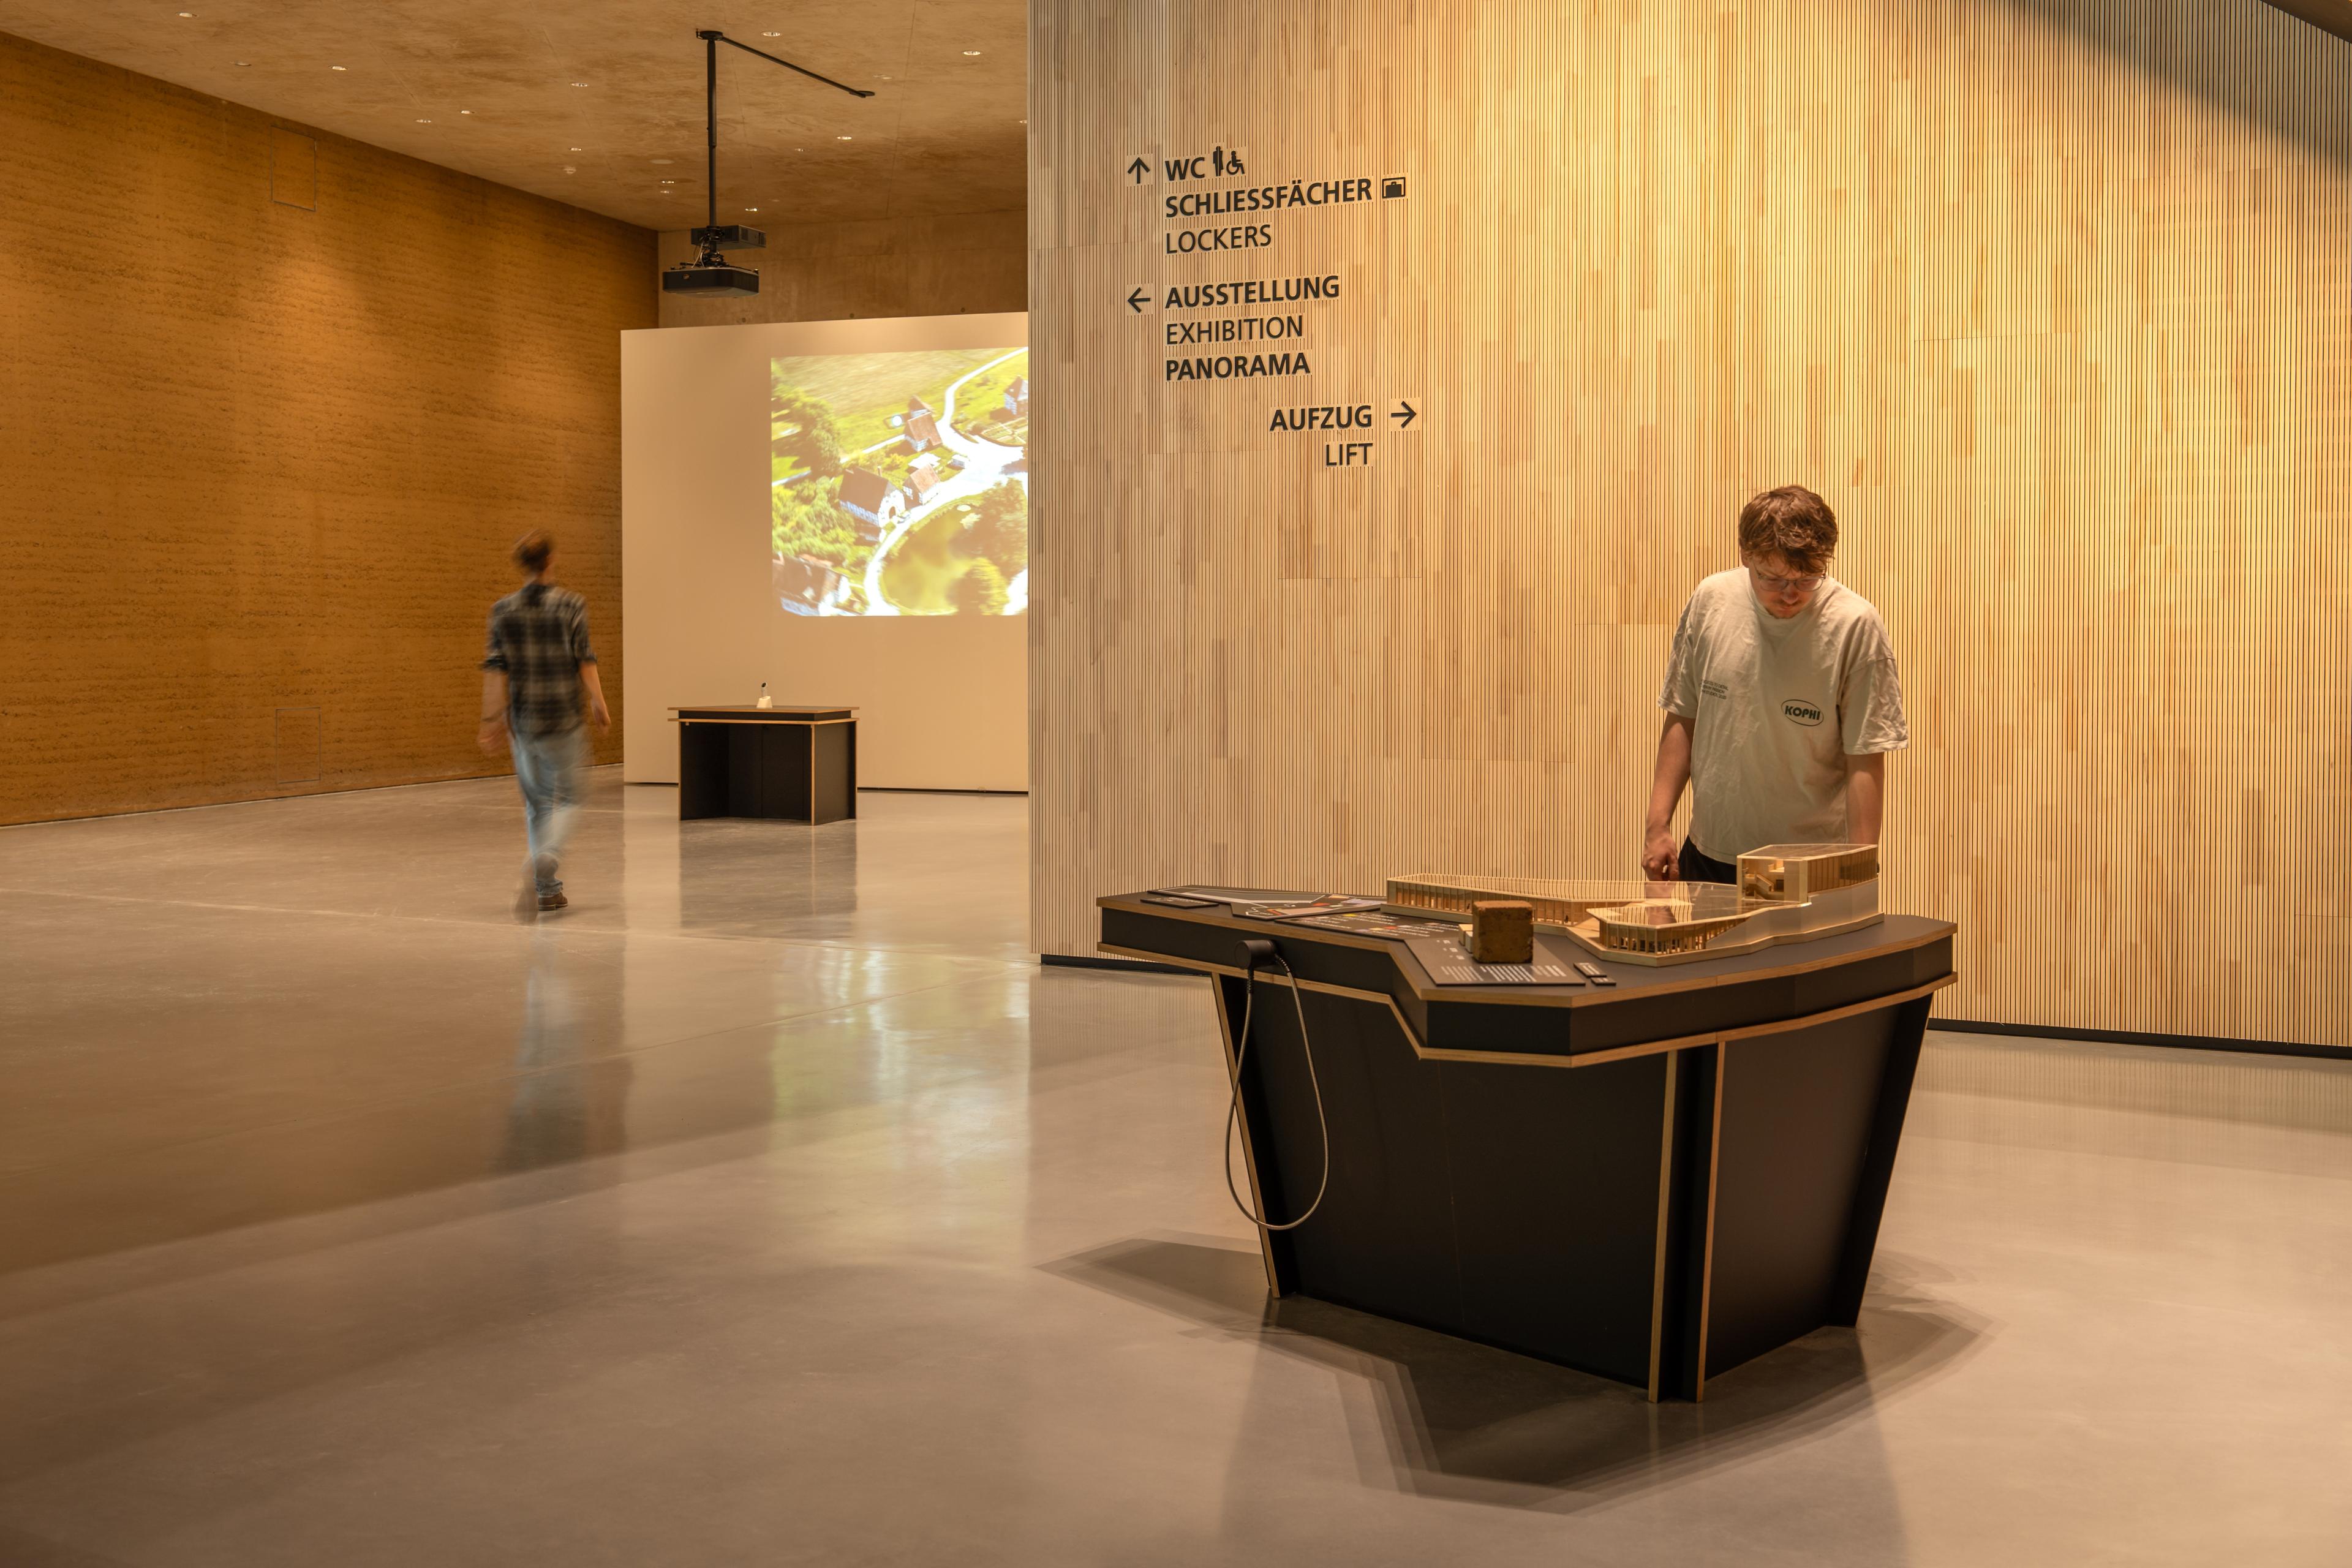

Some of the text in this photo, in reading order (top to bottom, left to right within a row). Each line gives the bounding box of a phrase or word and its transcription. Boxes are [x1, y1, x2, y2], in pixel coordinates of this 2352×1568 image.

[1165, 157, 1205, 181] WC
[1166, 180, 1371, 217] SCHLIESSFÄCHER
[1166, 224, 1271, 254] LOCKERS
[1165, 276, 1339, 309] AUSSTELLUNG
[1167, 315, 1302, 344] EXHIBITION
[1166, 352, 1310, 380] PANORAMA
[1270, 405, 1371, 431] AUFZUG
[1326, 443, 1373, 466] LIFT
[1785, 705, 1820, 720] KOPHI
